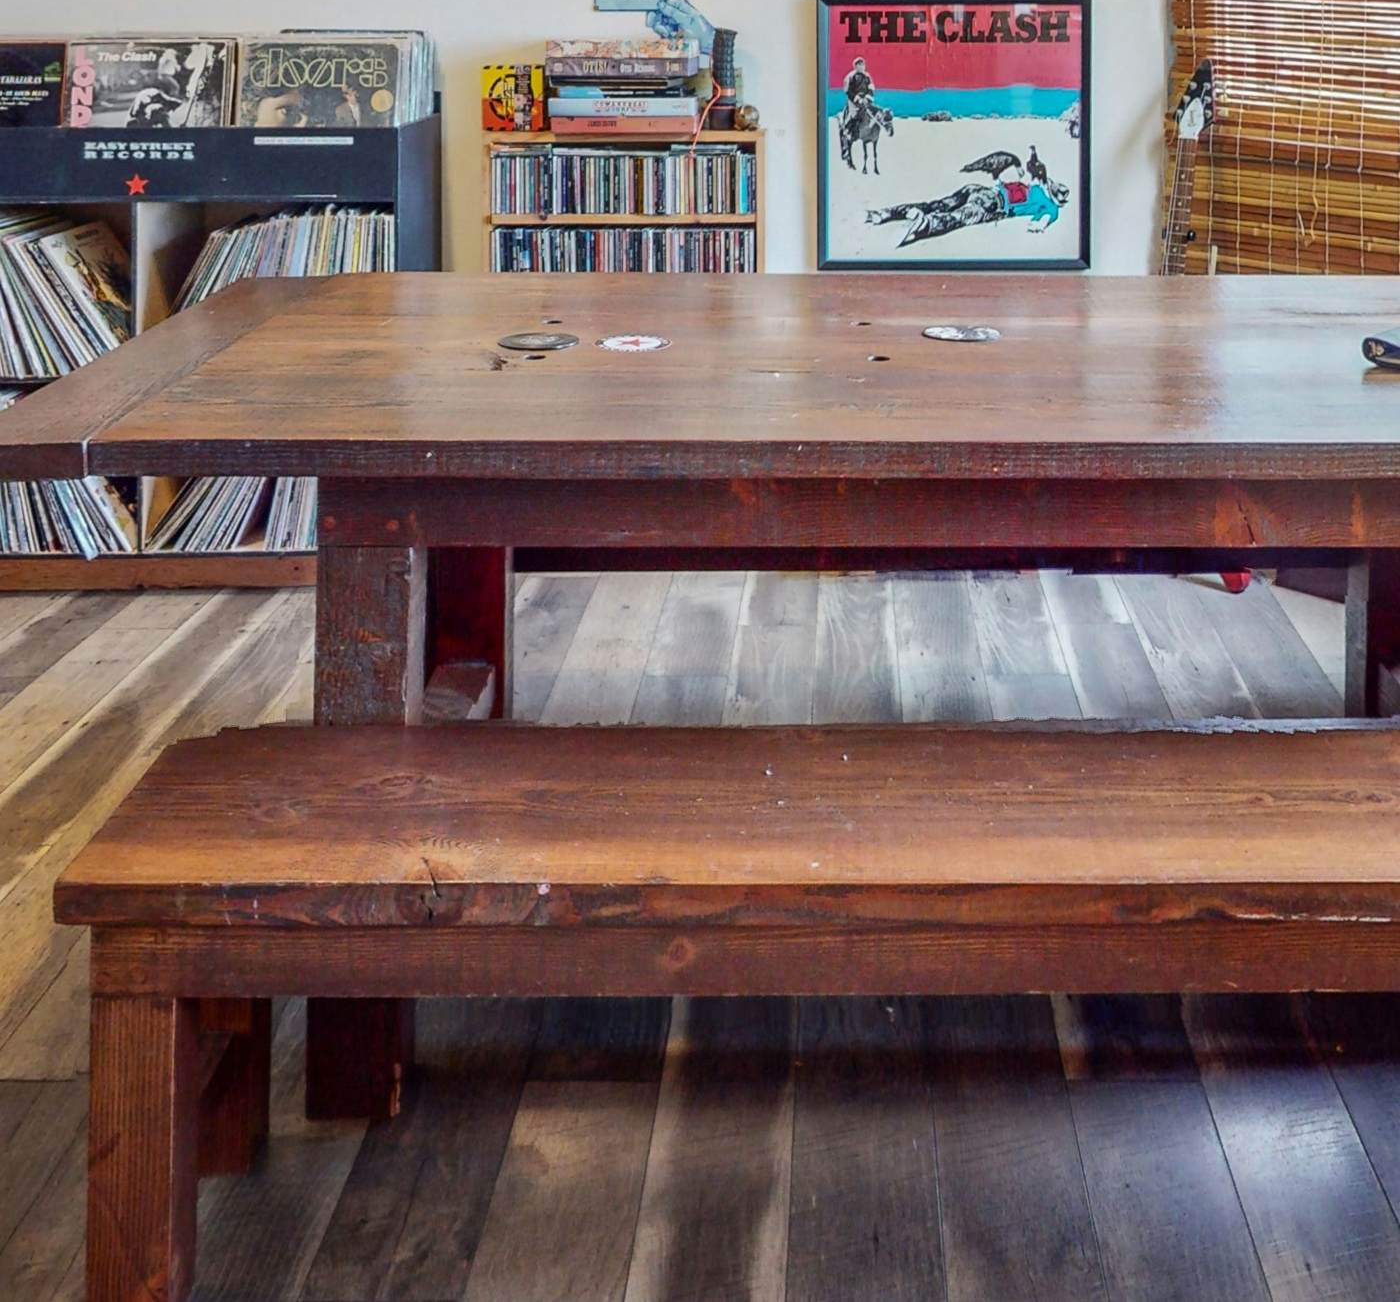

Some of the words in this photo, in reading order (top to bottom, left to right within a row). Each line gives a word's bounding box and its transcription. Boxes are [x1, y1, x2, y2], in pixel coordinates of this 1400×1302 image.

[839, 10, 928, 43] THE
[932, 10, 1071, 43] CLASH
[97, 51, 121, 62] The
[121, 51, 157, 62] Clash
[83, 141, 128, 151] EASY
[129, 141, 196, 151] STREET
[83, 150, 195, 160] RECORDS
